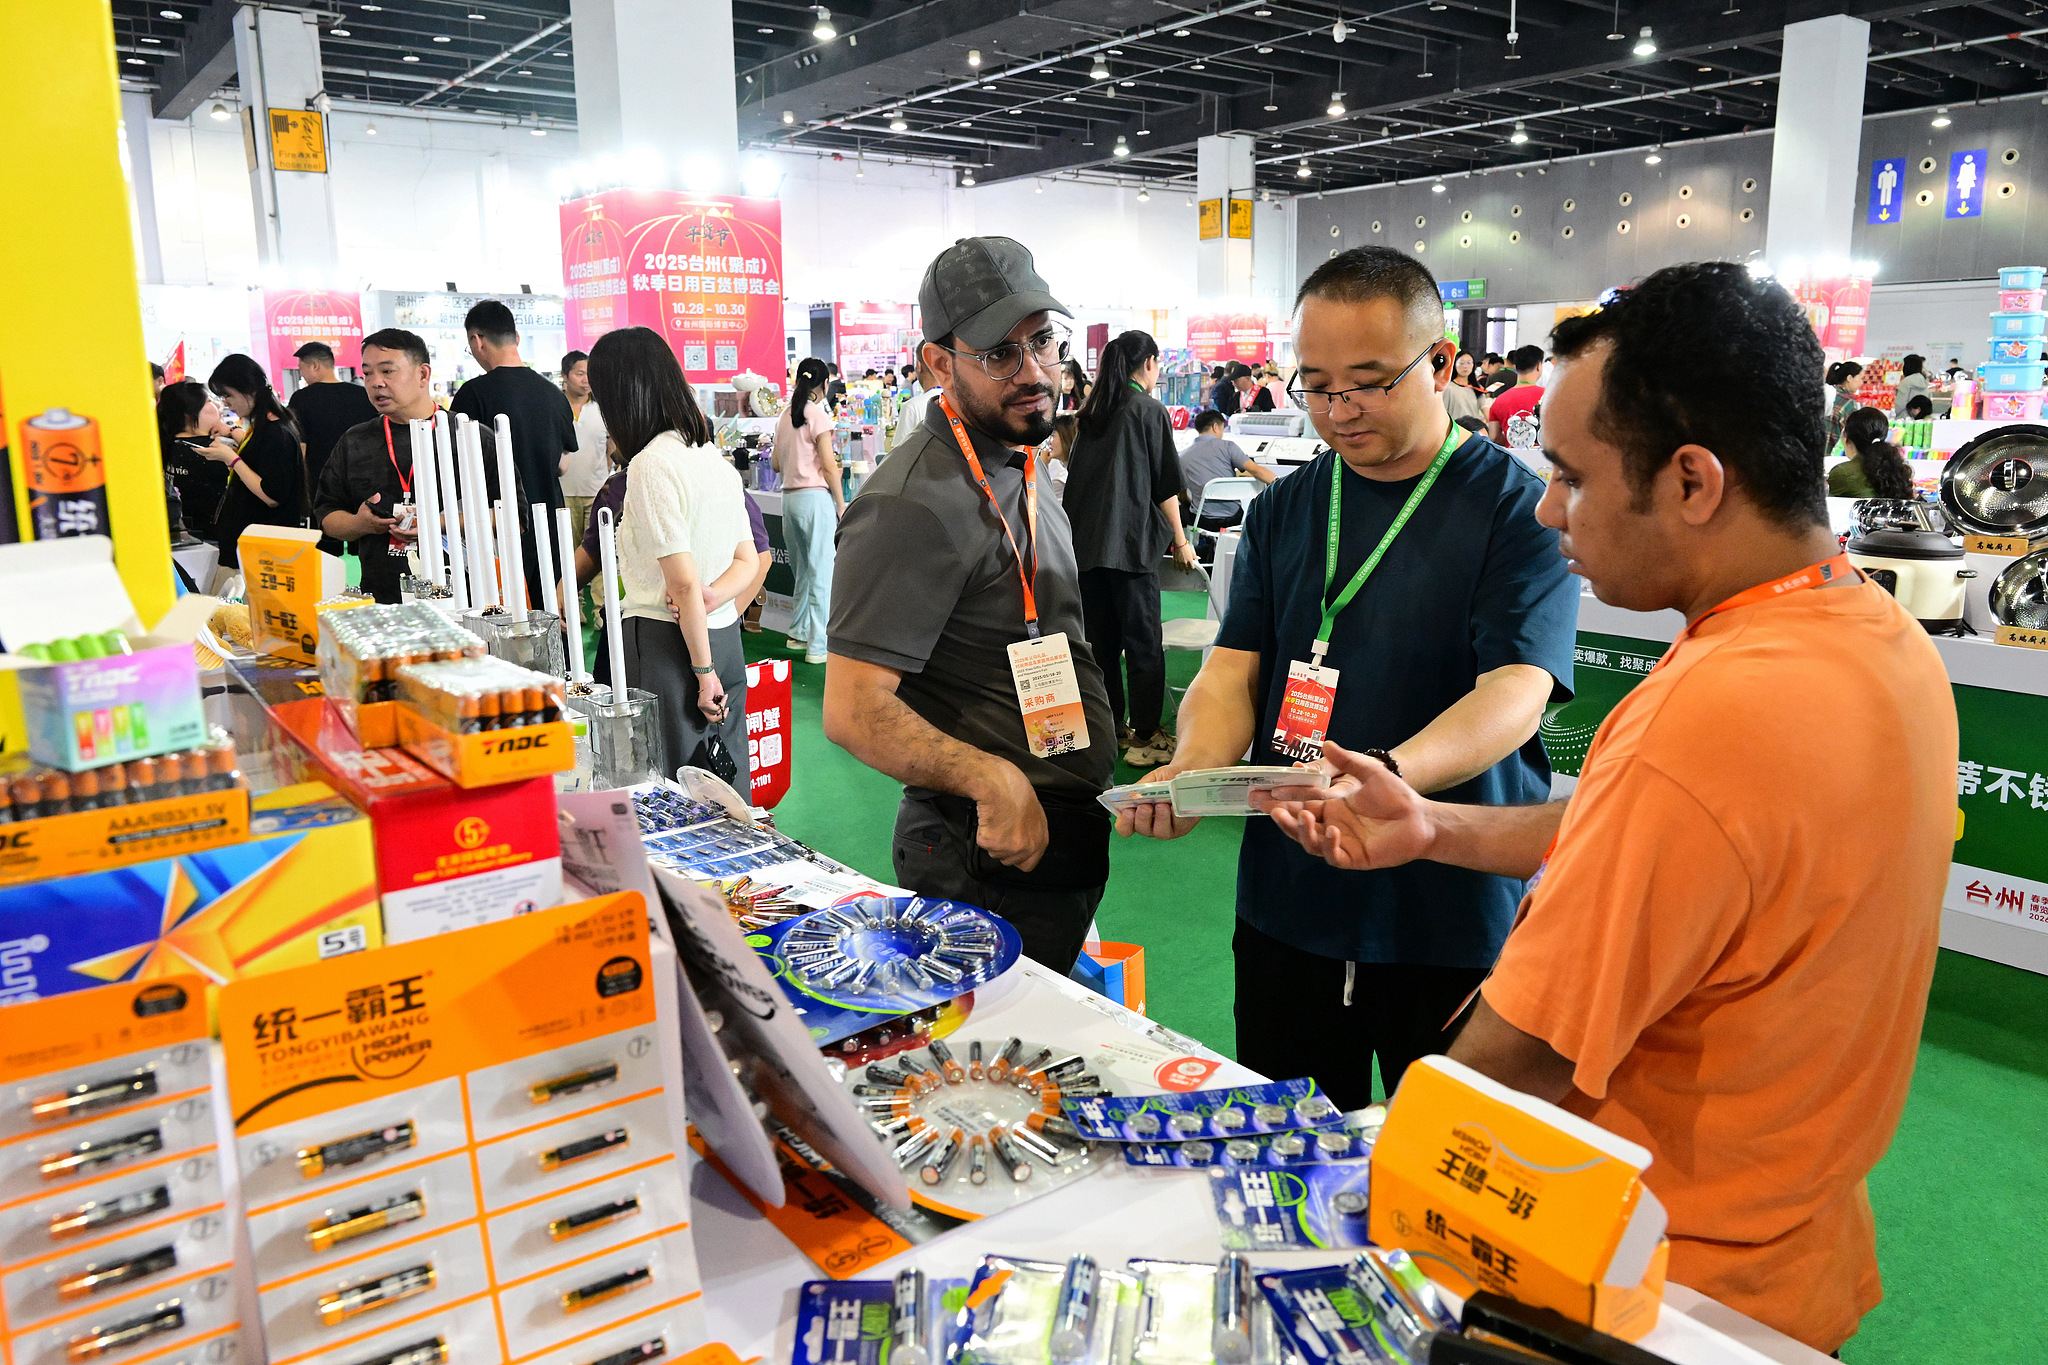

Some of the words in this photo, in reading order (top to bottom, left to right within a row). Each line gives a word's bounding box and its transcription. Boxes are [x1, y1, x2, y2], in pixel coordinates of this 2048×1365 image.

[644, 254, 768, 275] 2025台州(聚成)
[633, 274, 780, 295] 秋季日用百货博览会
[672, 303, 704, 315] 10.28
[714, 303, 746, 315] 10.30
[683, 320, 744, 330] 台州国际博览中心
[1023, 692, 1056, 709] 采购商
[1966, 880, 2025, 916] 台州
[253, 973, 428, 1050] 统一霸王
[259, 1012, 430, 1066] TONGYIBAWANG
[362, 1031, 412, 1053] HIGH
[364, 1039, 433, 1066] POWER
[1433, 1147, 1538, 1221] 统一霸王
[1425, 1208, 1521, 1285] 统一霸王
